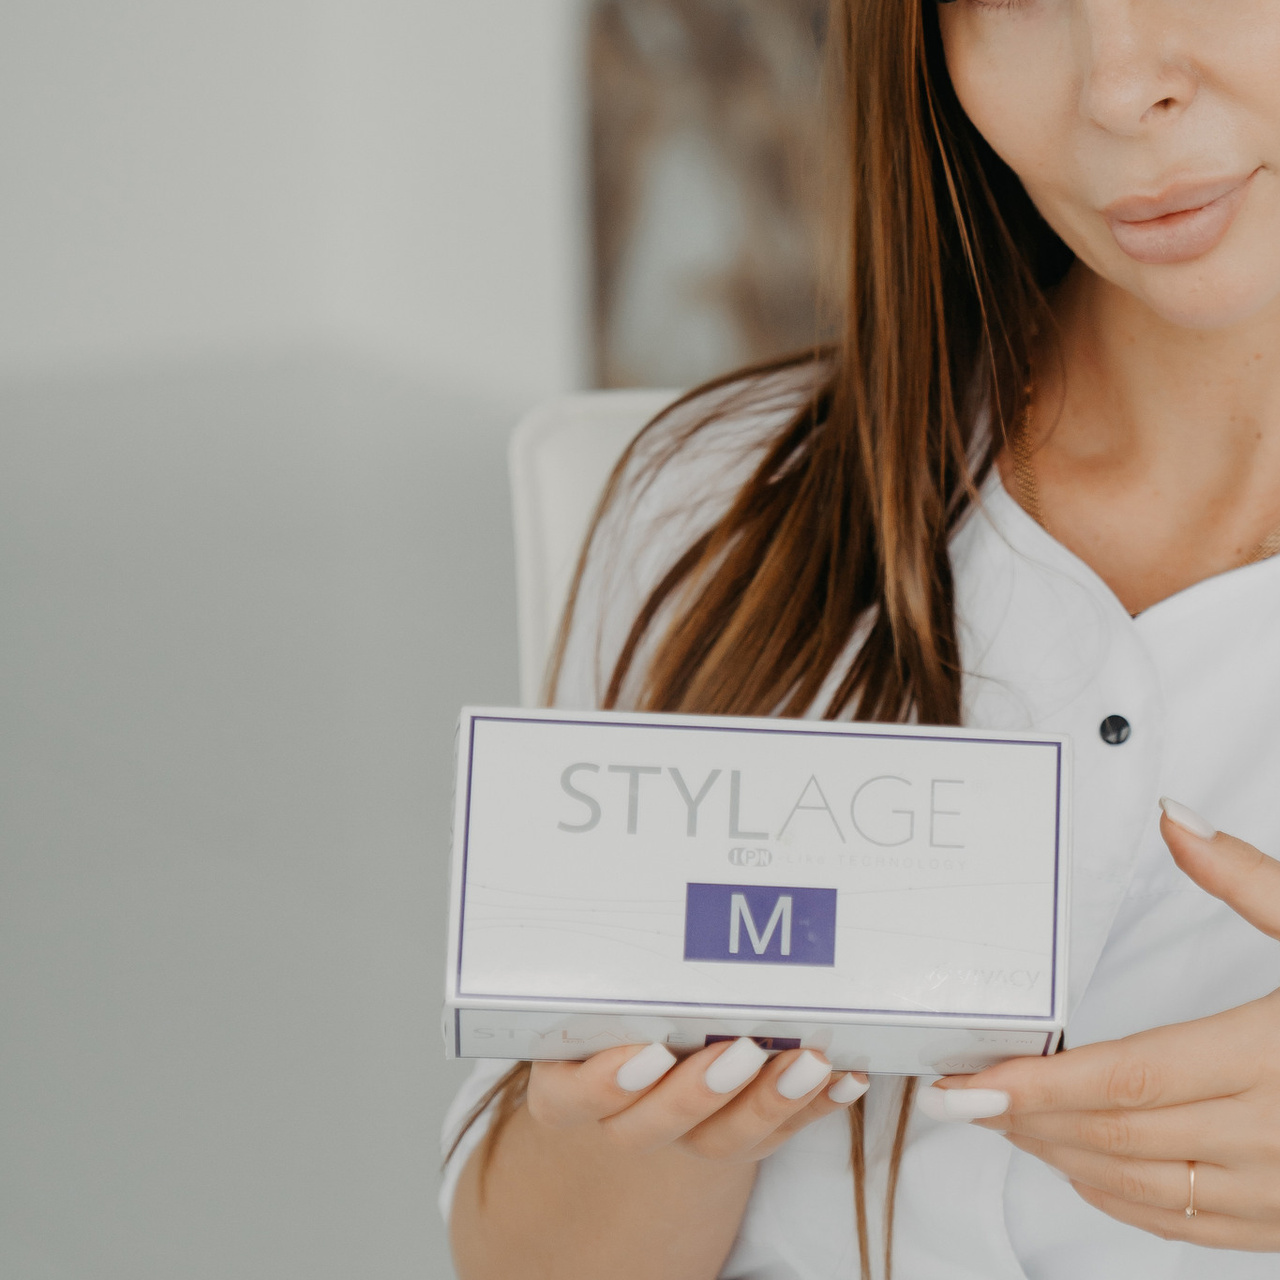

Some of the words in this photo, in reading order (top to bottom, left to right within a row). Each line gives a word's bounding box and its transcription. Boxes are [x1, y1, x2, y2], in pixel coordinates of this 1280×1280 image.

[556, 761, 966, 850] STYLAGE
[727, 892, 795, 958] M
[472, 1026, 688, 1044] STYLAE
[944, 1062, 993, 1070] VIVA
